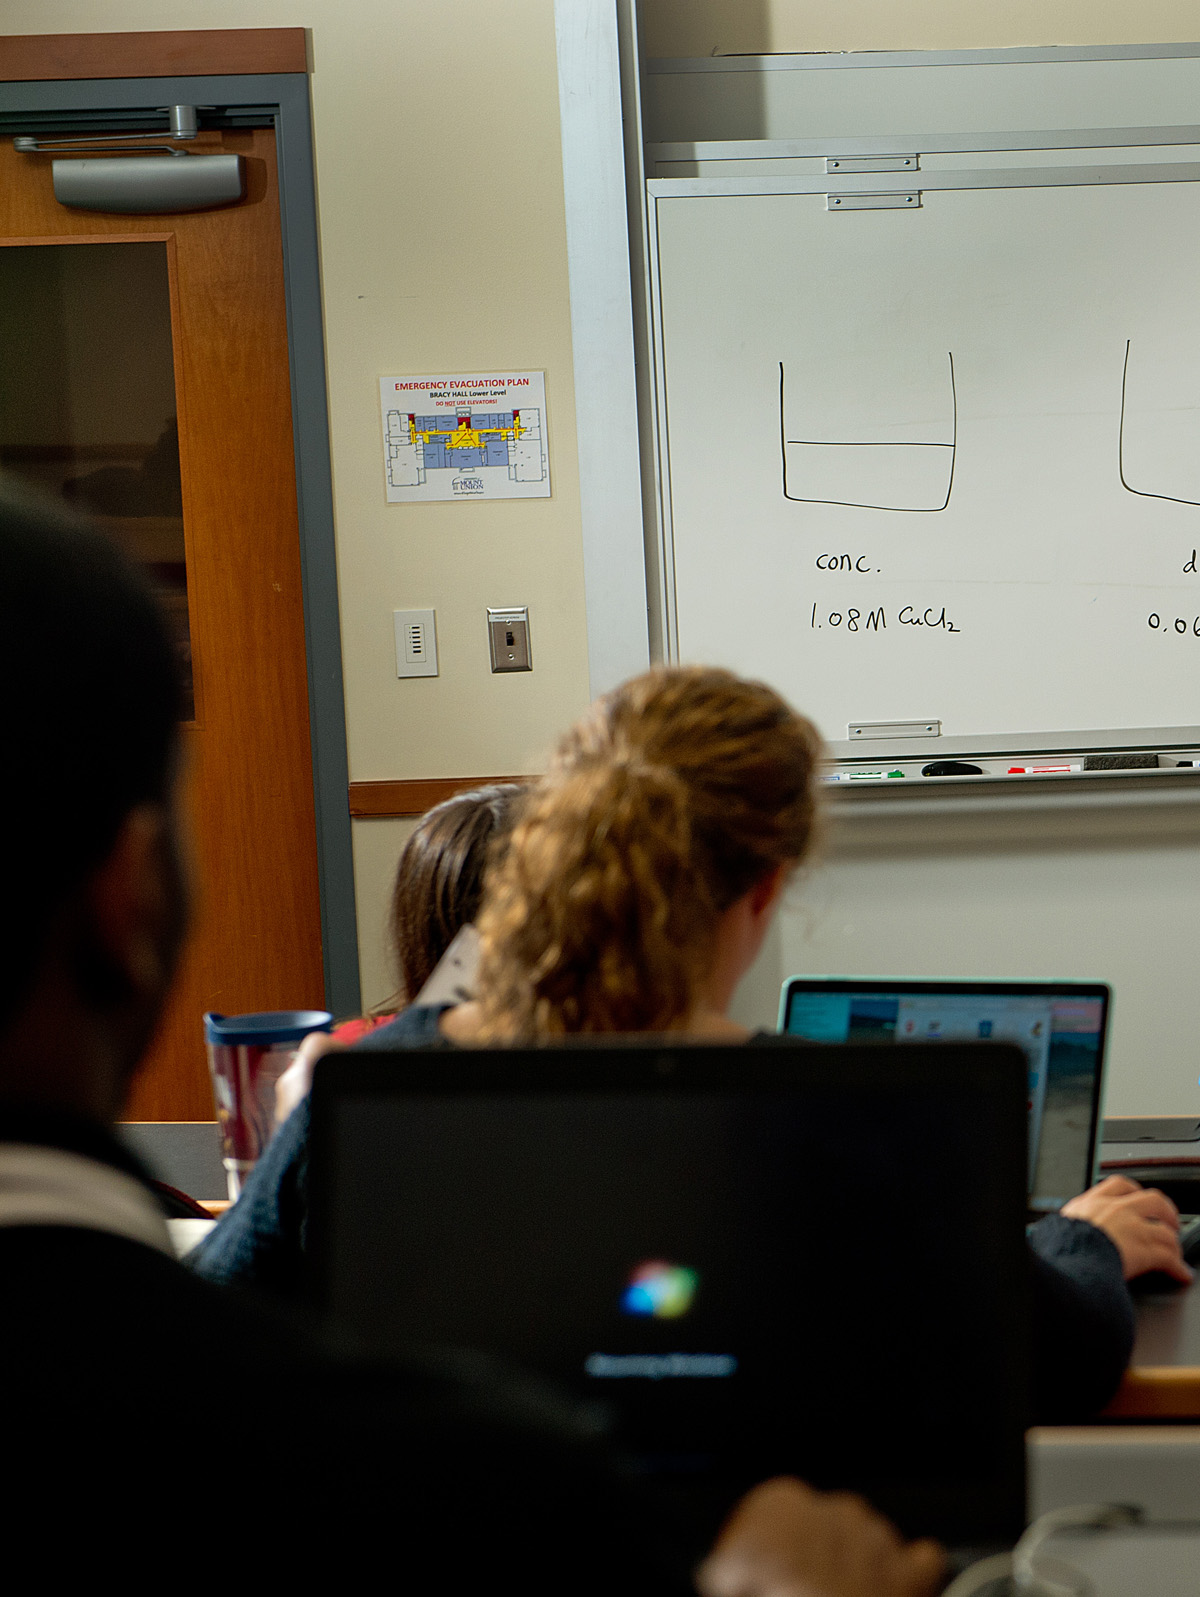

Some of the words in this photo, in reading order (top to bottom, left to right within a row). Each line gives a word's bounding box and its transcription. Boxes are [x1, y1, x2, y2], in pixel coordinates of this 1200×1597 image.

[394, 381, 448, 391] EMERGENCY
[449, 378, 505, 389] EVACUATION
[507, 378, 530, 386] PLAN
[815, 552, 883, 574] conc.
